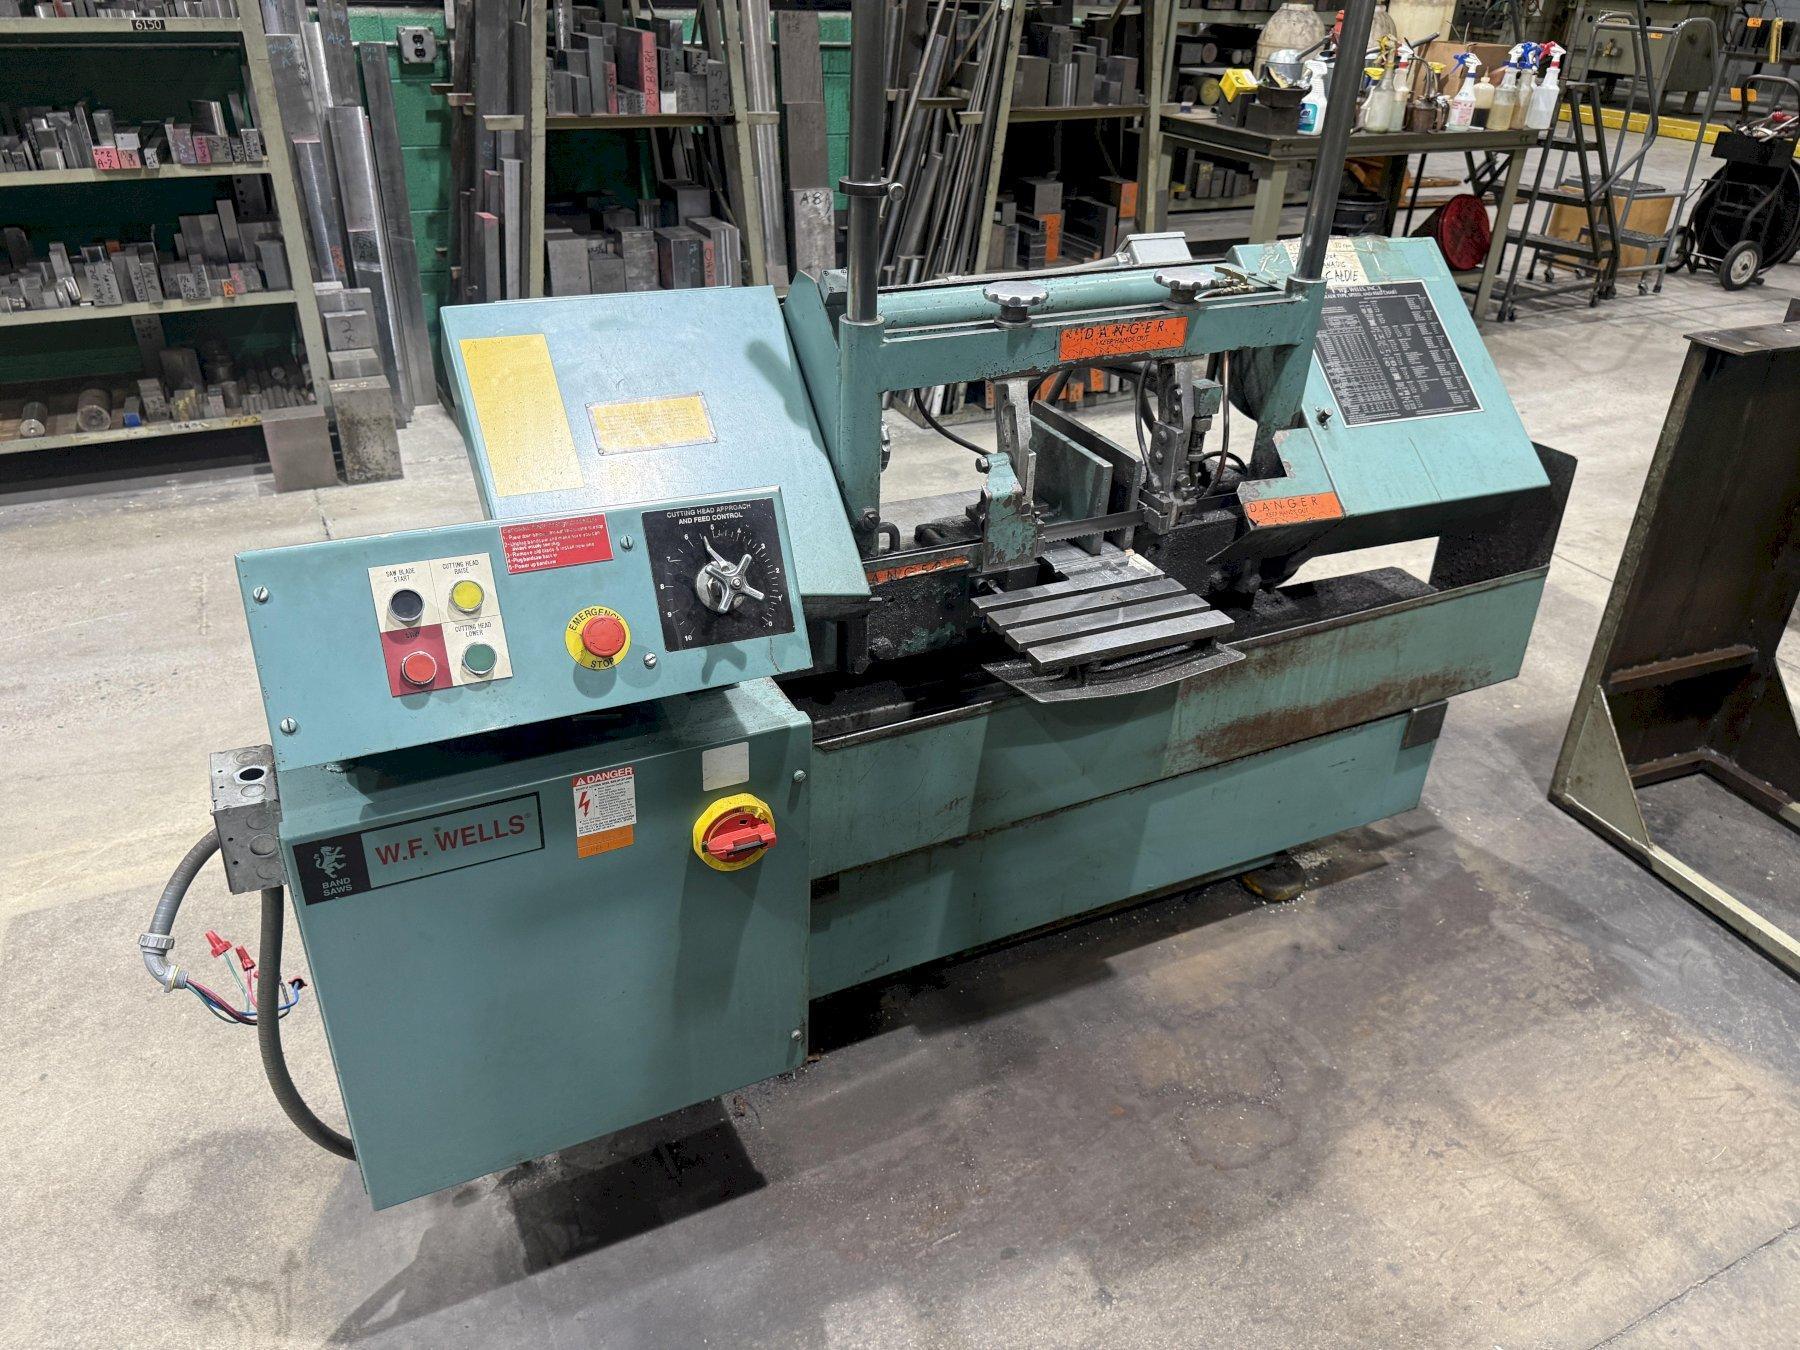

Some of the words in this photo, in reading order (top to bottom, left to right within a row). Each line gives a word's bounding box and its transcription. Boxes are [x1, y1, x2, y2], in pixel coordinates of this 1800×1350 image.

[136, 20, 161, 30] 6150
[1085, 320, 1165, 340] DANGER
[1137, 334, 1149, 342] OUT
[666, 509, 695, 518] CUTTING
[697, 507, 715, 515] HEAD
[716, 503, 751, 513] APPROACH
[1250, 496, 1319, 513] DANGER
[678, 517, 692, 525] AND
[693, 515, 711, 523] FEED
[712, 512, 743, 521] CONTROL
[512, 550, 533, 558] Remove
[442, 561, 464, 570] CUTTING
[465, 559, 480, 567] HEAD
[385, 570, 397, 578] SAW
[398, 567, 416, 576] BLADE
[454, 567, 470, 575] RAISE
[393, 575, 410, 583] START
[454, 624, 477, 633] CUTTING
[477, 621, 492, 630] HEAD
[465, 629, 484, 637] LOWER
[590, 657, 614, 669] STOP
[587, 766, 634, 784] DANGER
[375, 837, 429, 866] W.F.
[434, 814, 526, 852] WELLS
[322, 877, 351, 889] BAND
[323, 884, 353, 897] SAWS
